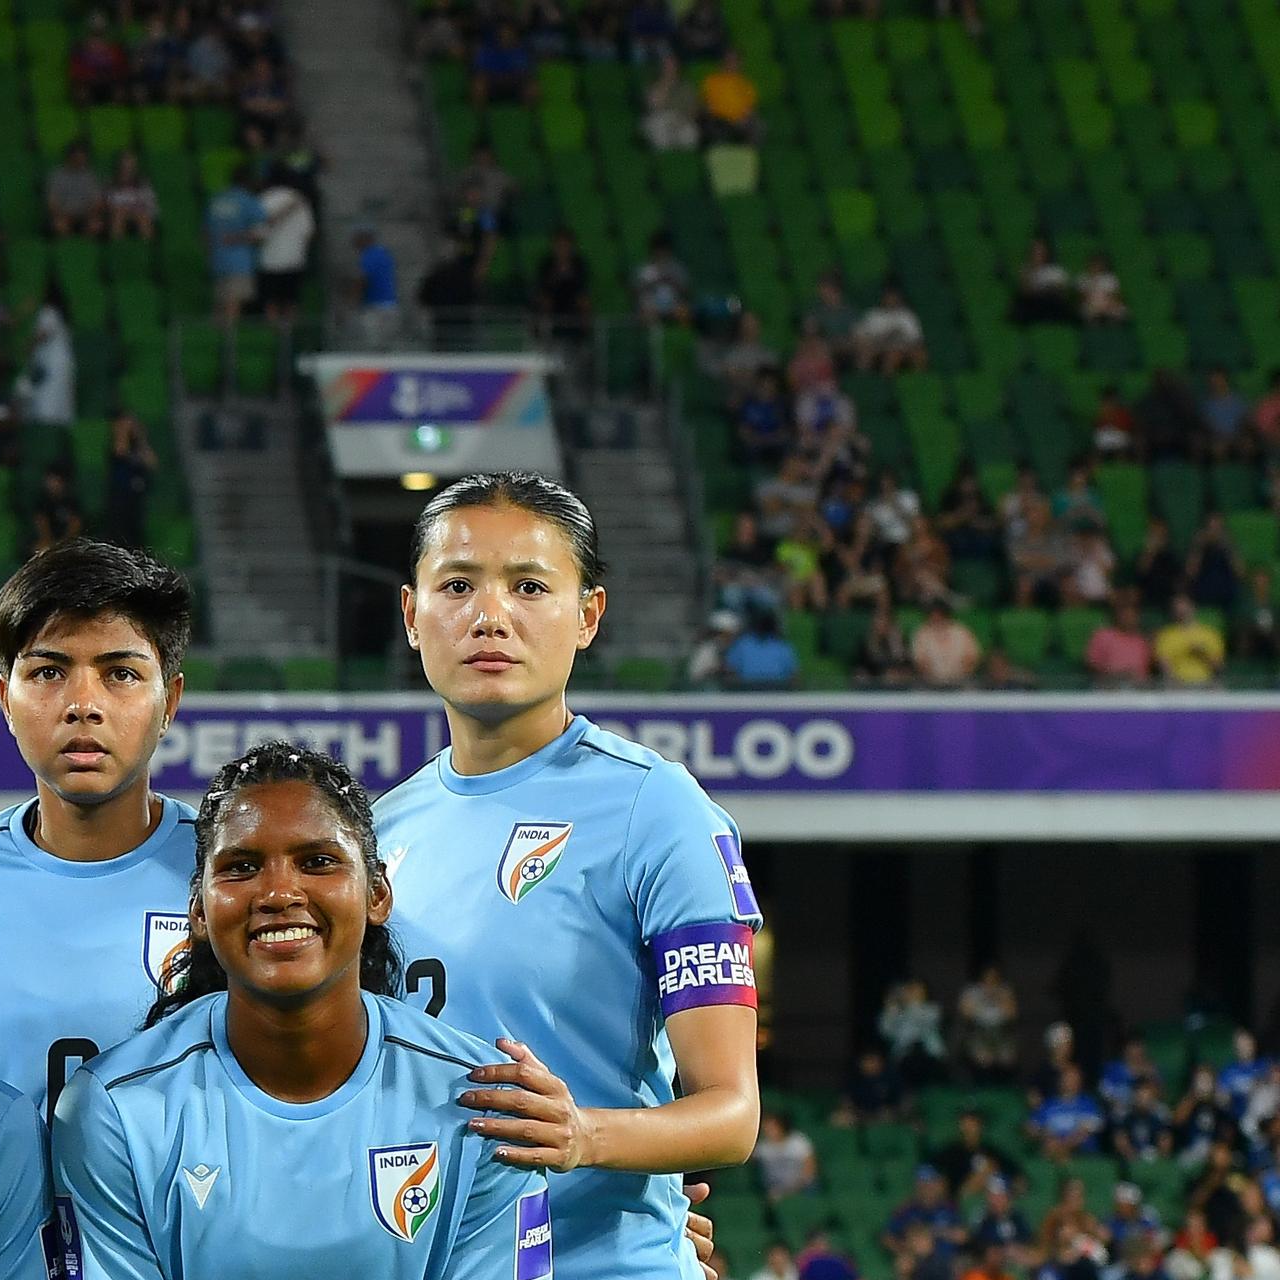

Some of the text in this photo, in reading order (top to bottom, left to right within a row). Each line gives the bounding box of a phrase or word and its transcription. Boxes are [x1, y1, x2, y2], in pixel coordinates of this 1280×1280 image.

[518, 830, 550, 840] INDIA
[154, 920, 191, 931] INDIA
[664, 942, 750, 972] DREAM
[380, 1154, 419, 1169] INDIA
